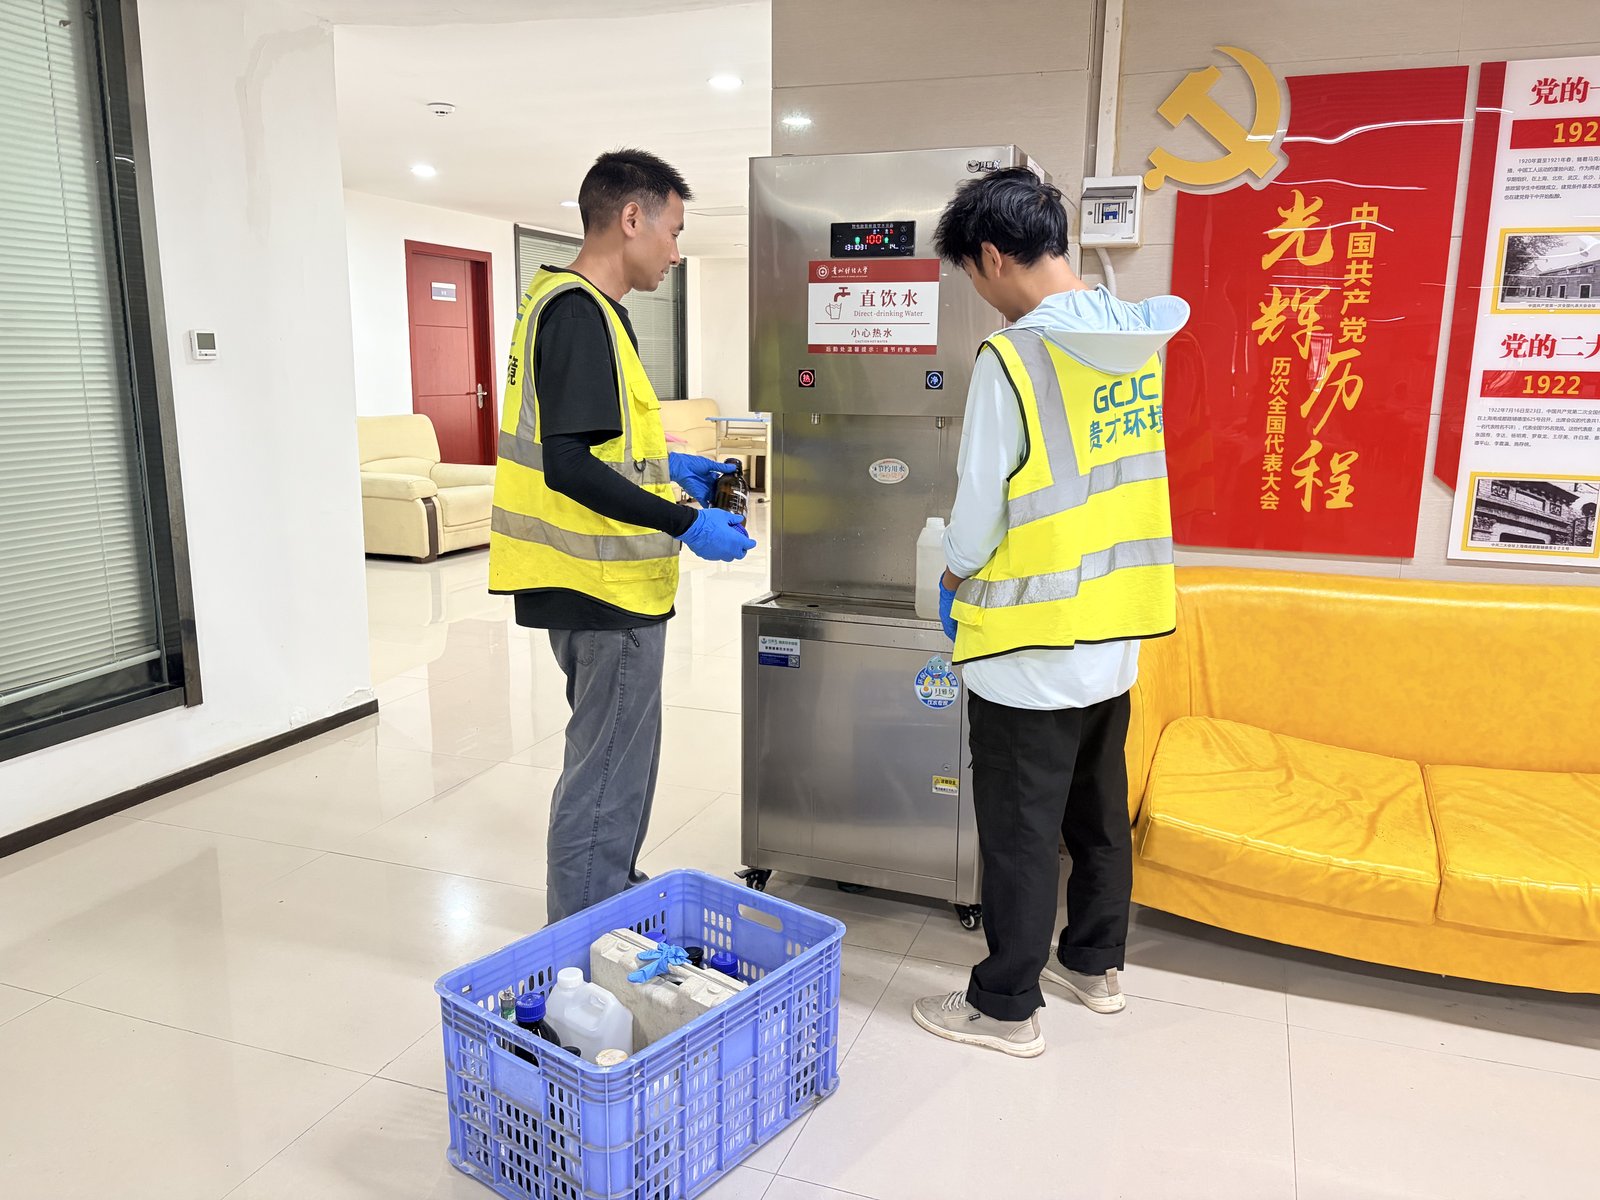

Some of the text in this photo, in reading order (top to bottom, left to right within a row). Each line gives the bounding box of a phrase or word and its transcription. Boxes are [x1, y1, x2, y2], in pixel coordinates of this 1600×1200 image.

[1338, 201, 1379, 344] 中国共产党
[860, 289, 918, 308] 直饮水
[851, 328, 892, 338] 小心热水
[803, 374, 811, 383] 热
[1522, 375, 1581, 395] 1922
[1094, 373, 1159, 414] GCJC
[1260, 357, 1292, 511] 历次全国代表大会
